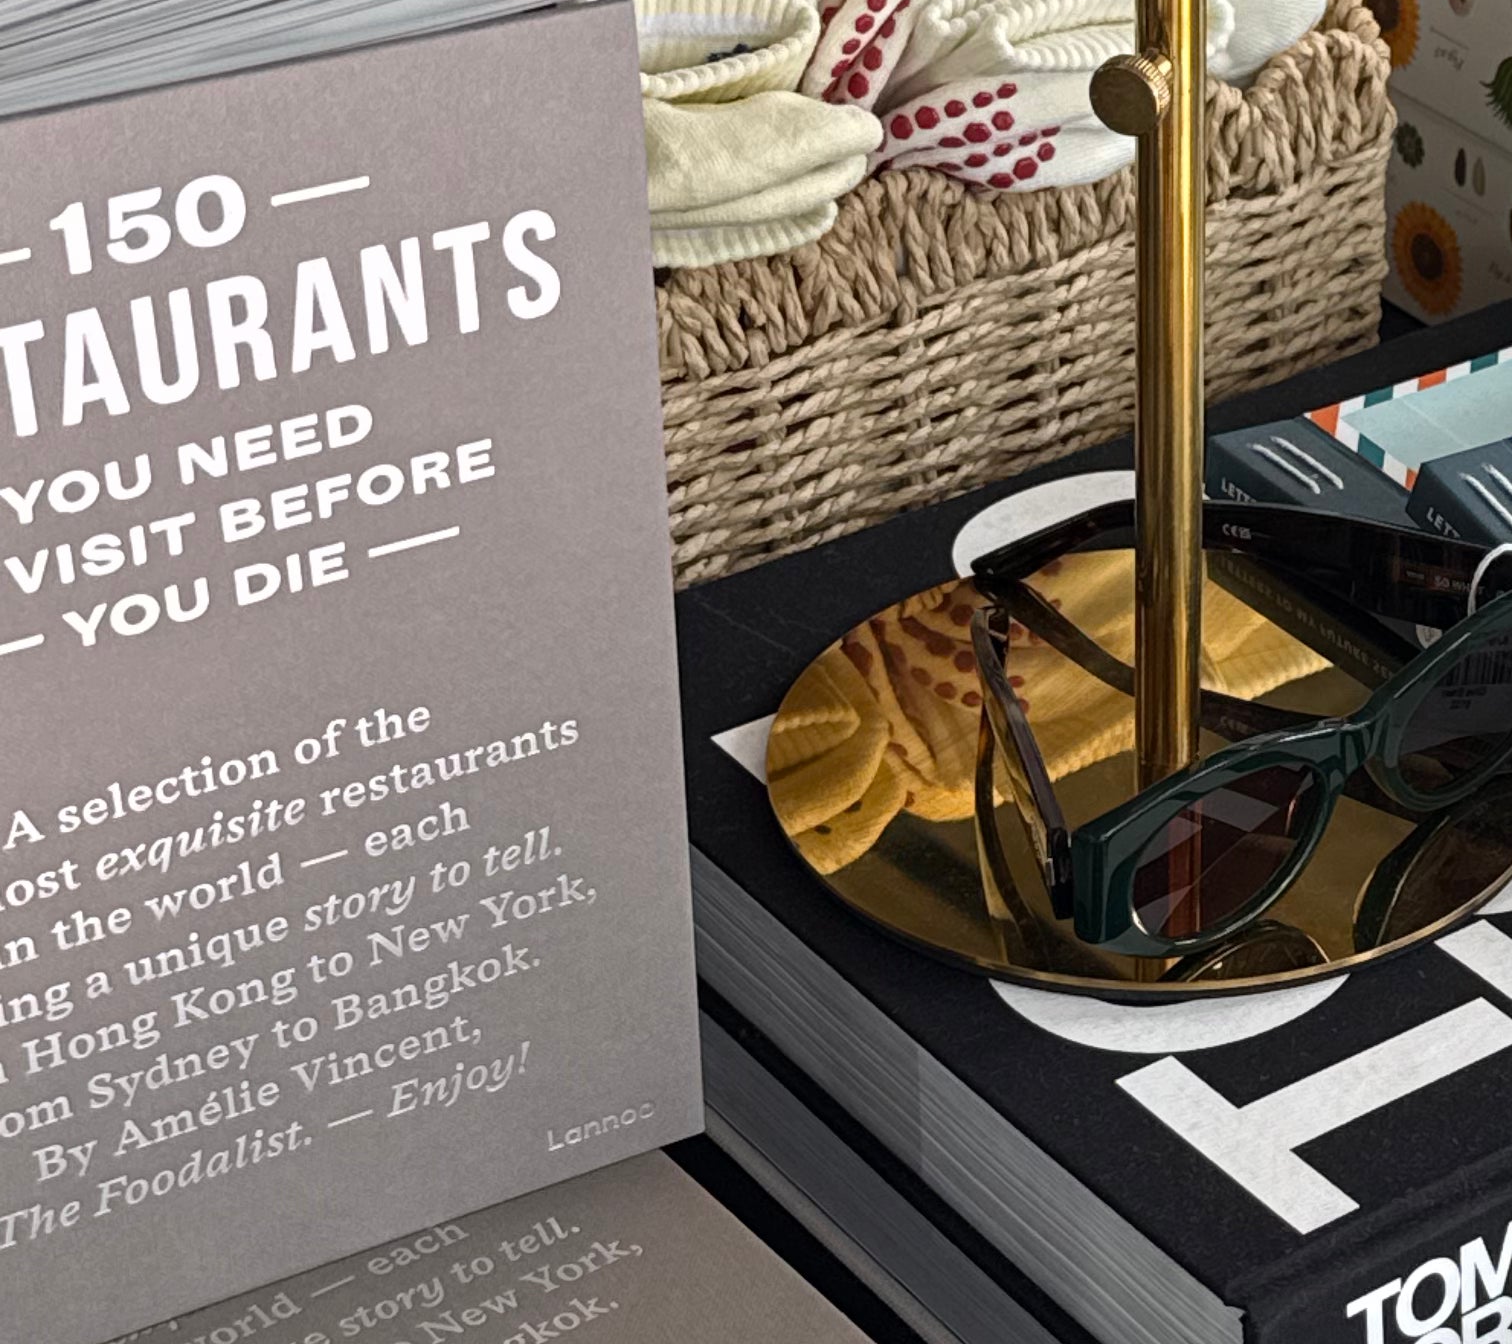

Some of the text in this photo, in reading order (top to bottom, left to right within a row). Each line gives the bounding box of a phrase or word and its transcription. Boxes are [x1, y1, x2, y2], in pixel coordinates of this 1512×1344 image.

[49, 173, 248, 275] 150
[0, 403, 374, 525] YOU NEED
[4, 438, 497, 594] VISIT BEFORE
[1220, 478, 1257, 503] LETT
[61, 541, 350, 648] YOU DIE
[1452, 580, 1486, 596] WHT
[0, 718, 581, 912] ost exquisite restaurants
[2, 706, 433, 852] A selection of the
[0, 800, 471, 970] n the world each
[85, 970, 113, 999] a
[123, 914, 290, 986] unique
[302, 876, 415, 935] story
[427, 859, 471, 895] to
[482, 824, 563, 876] tell.
[21, 870, 598, 1075] Hong Kong to New York,
[87, 1036, 259, 1110] Sydney
[271, 1016, 319, 1052] to
[331, 941, 543, 1031] Bangkok.
[0, 1039, 532, 1250] The Foodalist. Enjoy!
[32, 1012, 485, 1183] By Amélie Vincent,
[334, 1273, 448, 1339] story
[448, 1249, 497, 1289] to
[492, 1211, 585, 1266] tell.
[364, 1215, 471, 1279] each
[519, 1236, 646, 1298] York,
